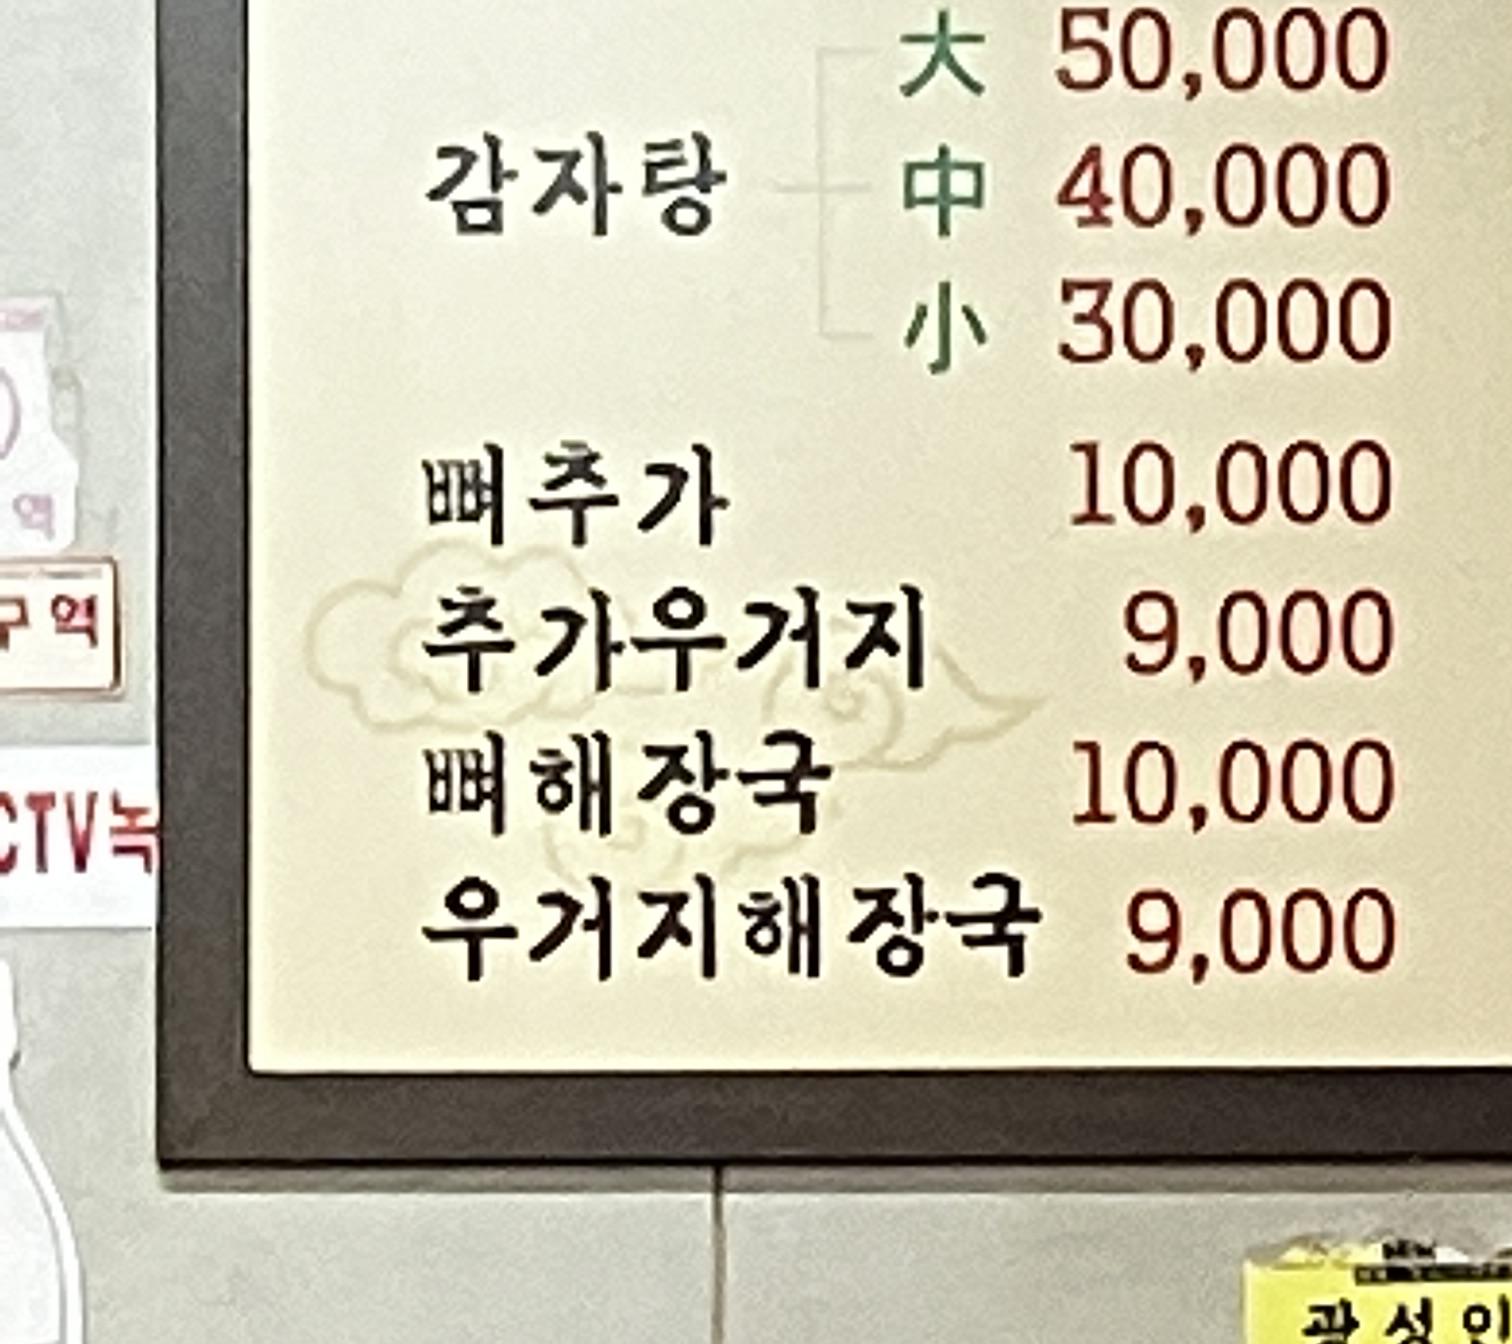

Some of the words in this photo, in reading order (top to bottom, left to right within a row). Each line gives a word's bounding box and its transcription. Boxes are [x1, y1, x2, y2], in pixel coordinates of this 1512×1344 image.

[900, 10, 985, 97] 大
[1056, 7, 1389, 101] 50,000
[425, 131, 727, 237] 감자탕
[904, 144, 984, 238] 中
[1057, 142, 1390, 237] 40,000
[905, 281, 986, 375] 小
[1058, 278, 1391, 373] 30,000
[421, 440, 730, 548] 뼈추가
[1070, 440, 1391, 534] 10,000
[422, 583, 924, 695] 추가우거지
[1124, 588, 1393, 684] 9,000
[422, 729, 834, 838] 뼈해장국
[1073, 738, 1394, 834] 10,000
[421, 872, 1043, 982] 우거지해장국
[1127, 888, 1395, 985] 9,000
